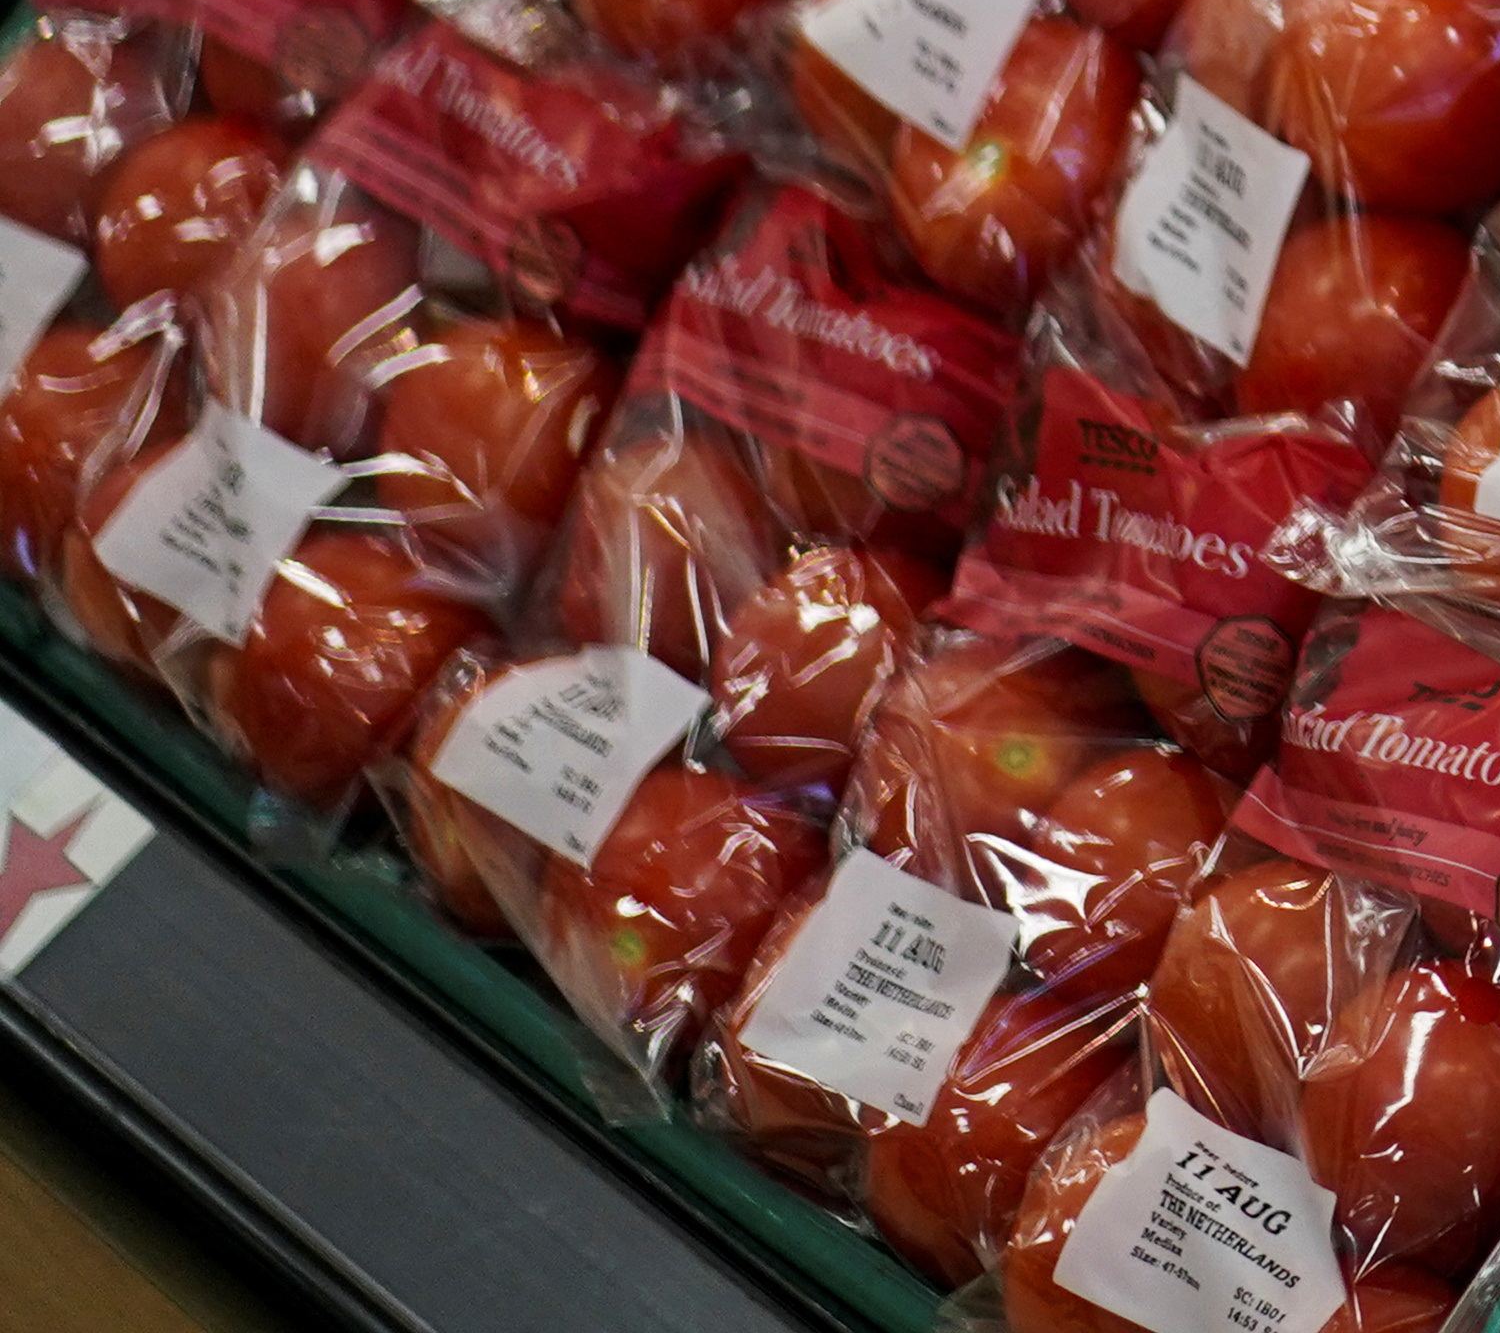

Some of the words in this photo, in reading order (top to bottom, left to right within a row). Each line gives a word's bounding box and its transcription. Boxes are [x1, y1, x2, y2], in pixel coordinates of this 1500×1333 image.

[1159, 1190, 1187, 1222] THE
[1184, 1205, 1302, 1290] NETHERLANDS
[1175, 1149, 1216, 1182] 11
[1215, 1182, 1294, 1238] AUG
